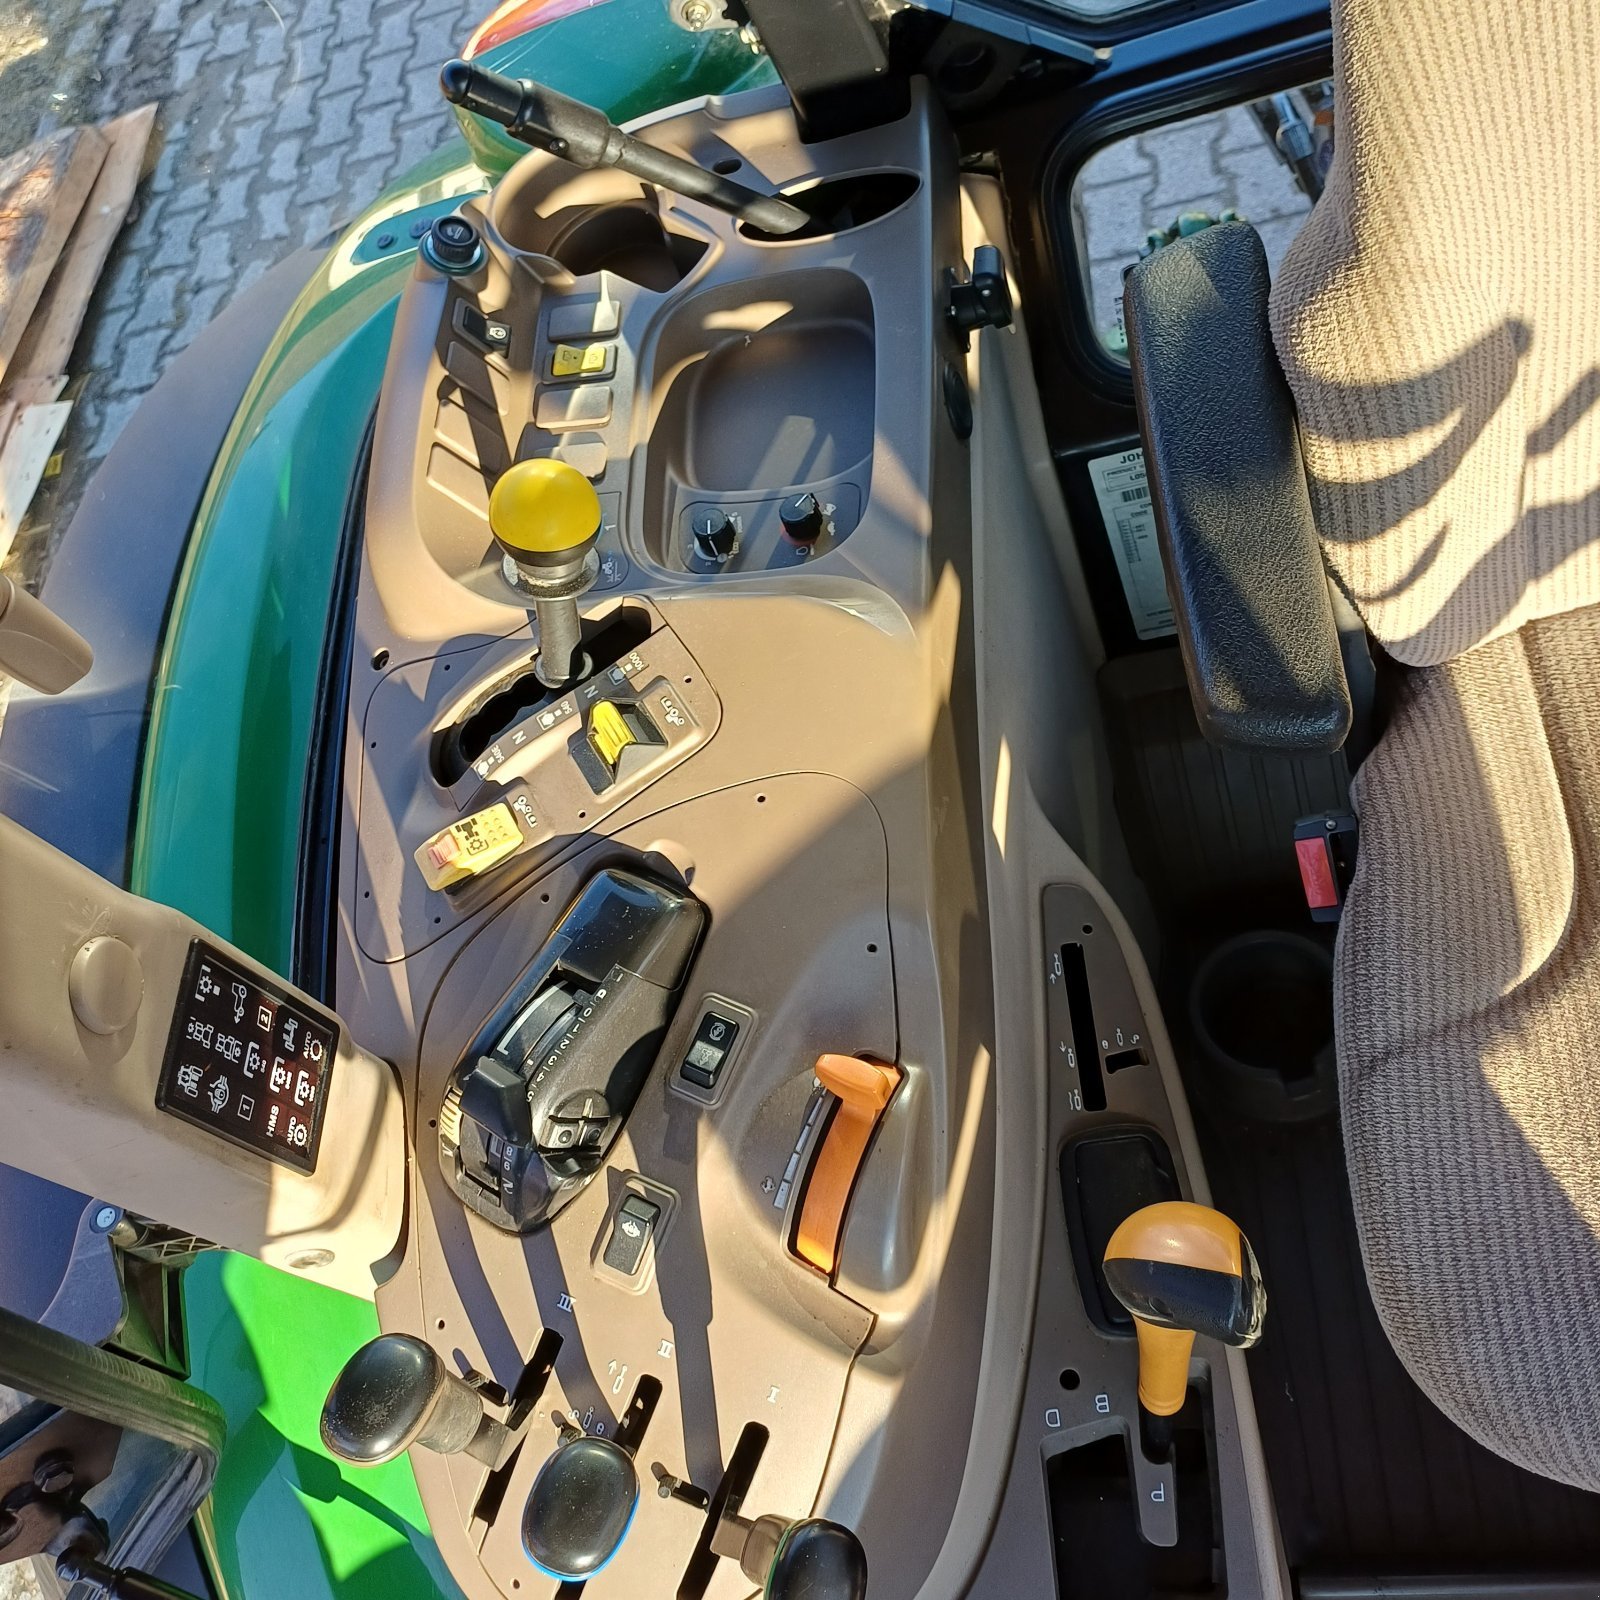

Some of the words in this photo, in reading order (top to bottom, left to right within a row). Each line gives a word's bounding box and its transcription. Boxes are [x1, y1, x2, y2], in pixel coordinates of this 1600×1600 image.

[1120, 453, 1144, 464] JOH
[629, 652, 645, 671] 1000
[584, 685, 599, 698] N
[560, 701, 573, 715] 540
[512, 730, 527, 745] N
[491, 744, 505, 763] 540E
[583, 1007, 593, 1017] 0
[261, 1015, 268, 1024] 2
[573, 1024, 581, 1033] 1
[303, 1031, 312, 1059] AUTO
[560, 1038, 570, 1049] 2
[548, 1055, 558, 1066] 3
[536, 1071, 545, 1083] 4
[526, 1091, 535, 1103] 5
[266, 1104, 280, 1137] HMS
[287, 1116, 296, 1145] AUTO
[506, 1146, 513, 1156] 8
[557, 1292, 577, 1313] III
[657, 1339, 675, 1359] II
[1095, 1394, 1110, 1413] B
[1045, 1408, 1060, 1428] D
[1150, 1482, 1165, 1502] P
